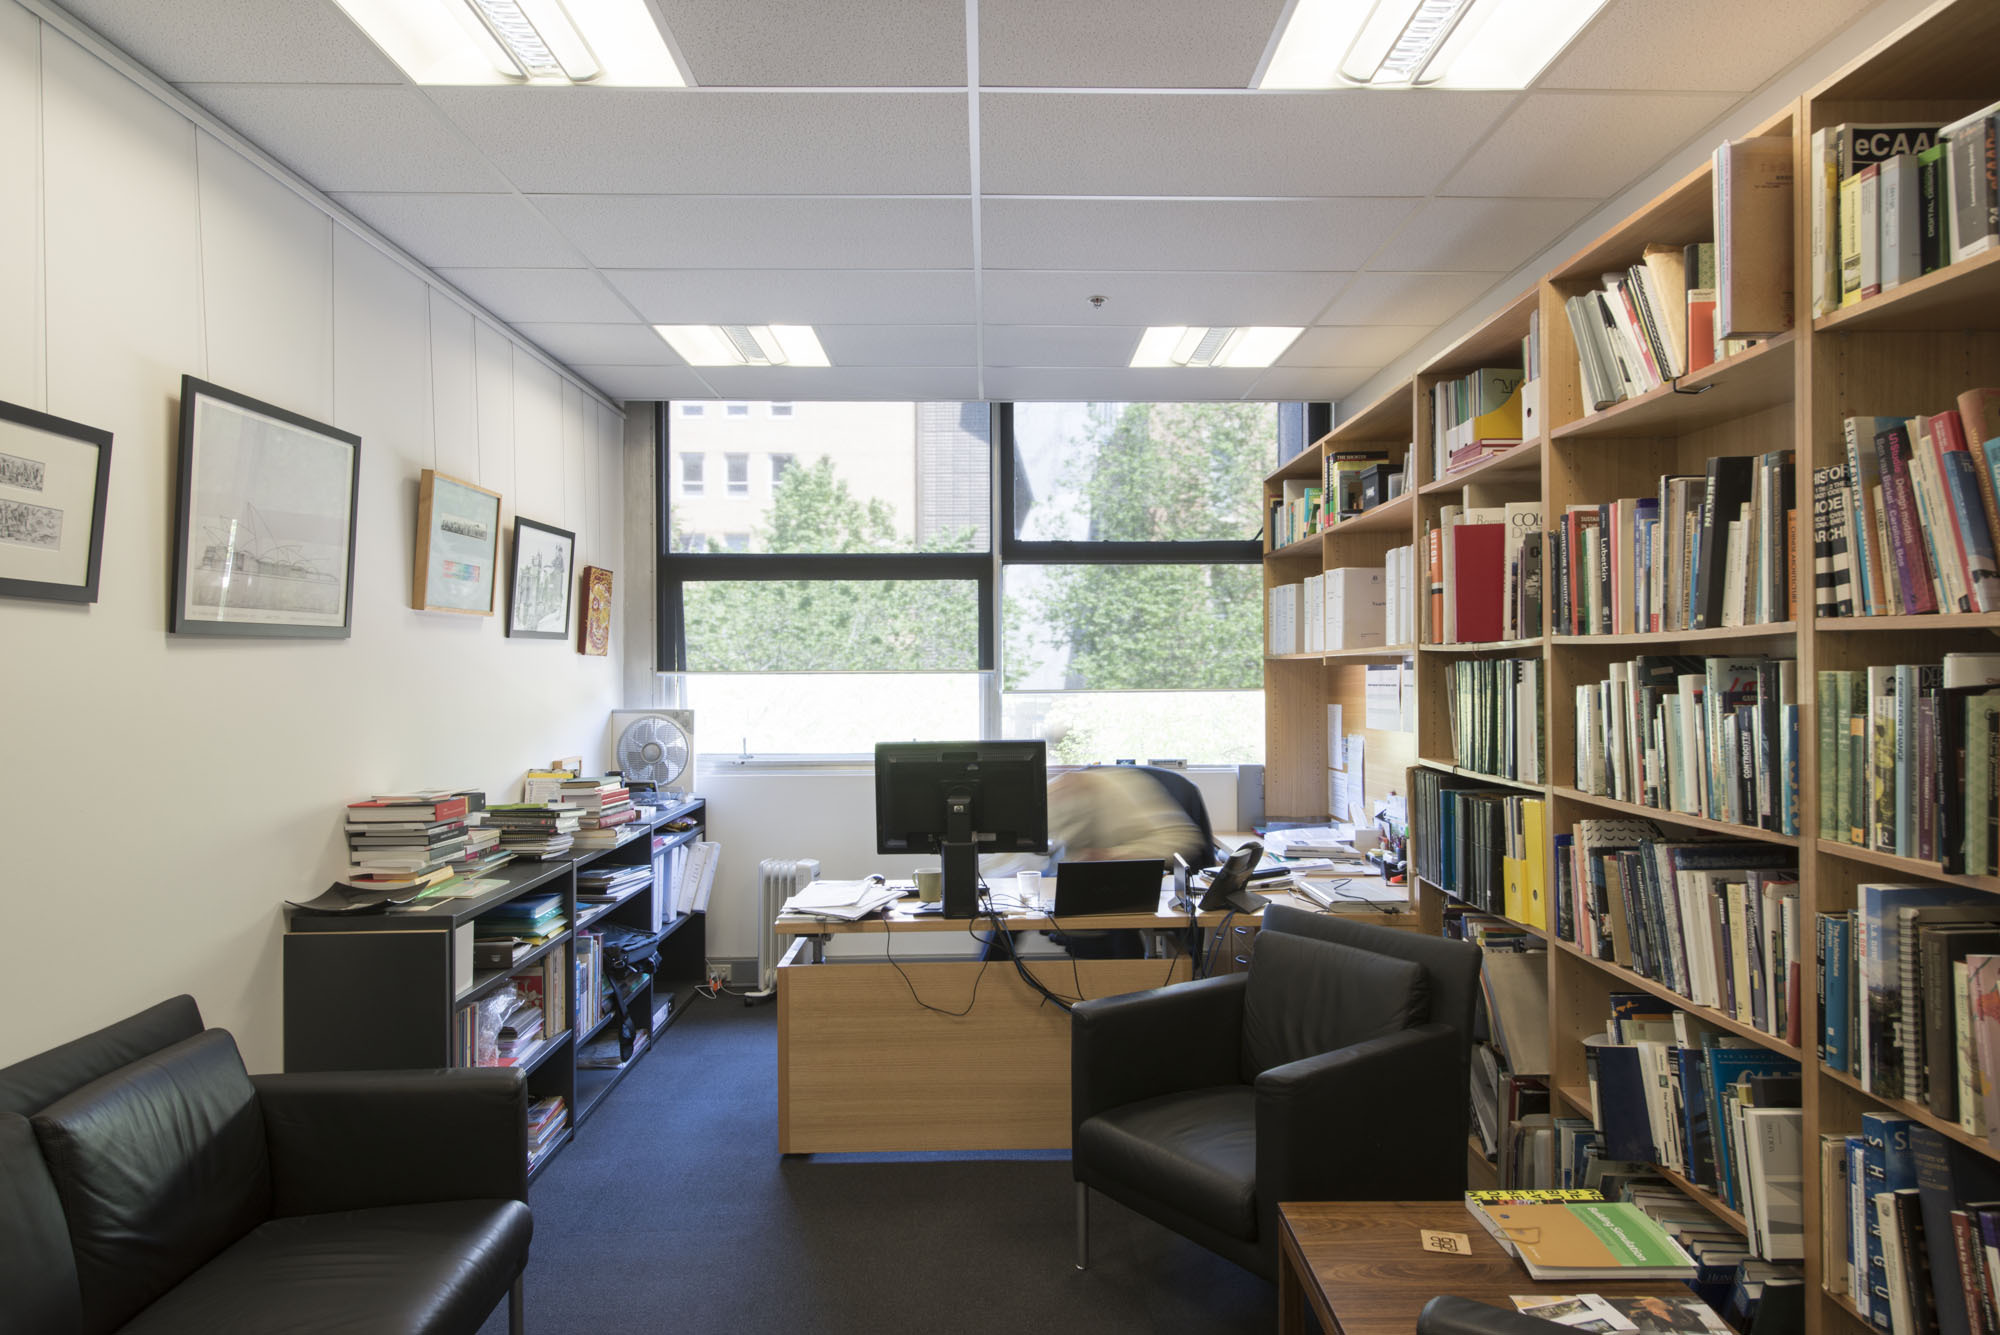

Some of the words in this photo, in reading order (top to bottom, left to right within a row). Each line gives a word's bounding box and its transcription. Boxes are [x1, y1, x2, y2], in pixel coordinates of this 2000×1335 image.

[1927, 197, 1936, 238] DIGITAL
[1876, 437, 1885, 458] Ben
[1704, 476, 1715, 527] BERLIN
[1883, 474, 1894, 504] Berkel
[1512, 512, 1543, 526] COL
[1894, 478, 1906, 508] Design
[1901, 508, 1914, 544] models
[1888, 510, 1901, 550] Caroline
[1896, 551, 1904, 567] Bos
[1870, 924, 1878, 938] L.A.
[1586, 1206, 1614, 1228] Building
[1610, 1225, 1647, 1262] Simulation
